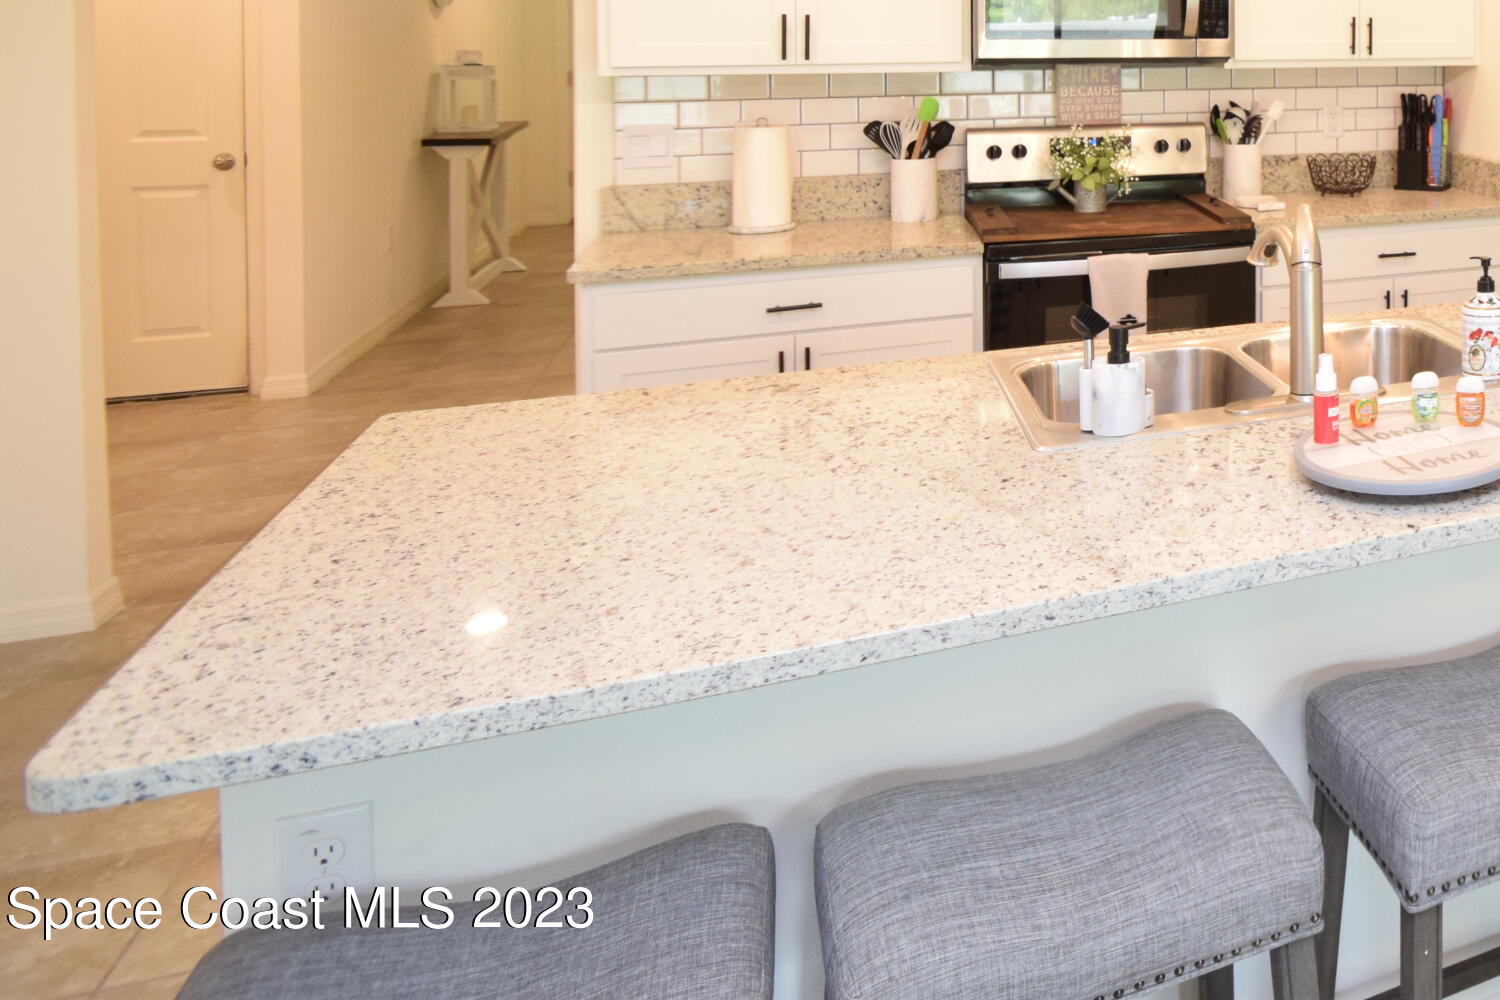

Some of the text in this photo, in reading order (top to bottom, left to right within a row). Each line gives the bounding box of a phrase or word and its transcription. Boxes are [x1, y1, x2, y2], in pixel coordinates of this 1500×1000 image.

[1060, 85, 1120, 97] BECAUSE
[1060, 104, 1081, 112] EVER
[1094, 111, 1120, 120] SALAD
[1338, 422, 1441, 447] Home
[1380, 448, 1490, 475] Home
